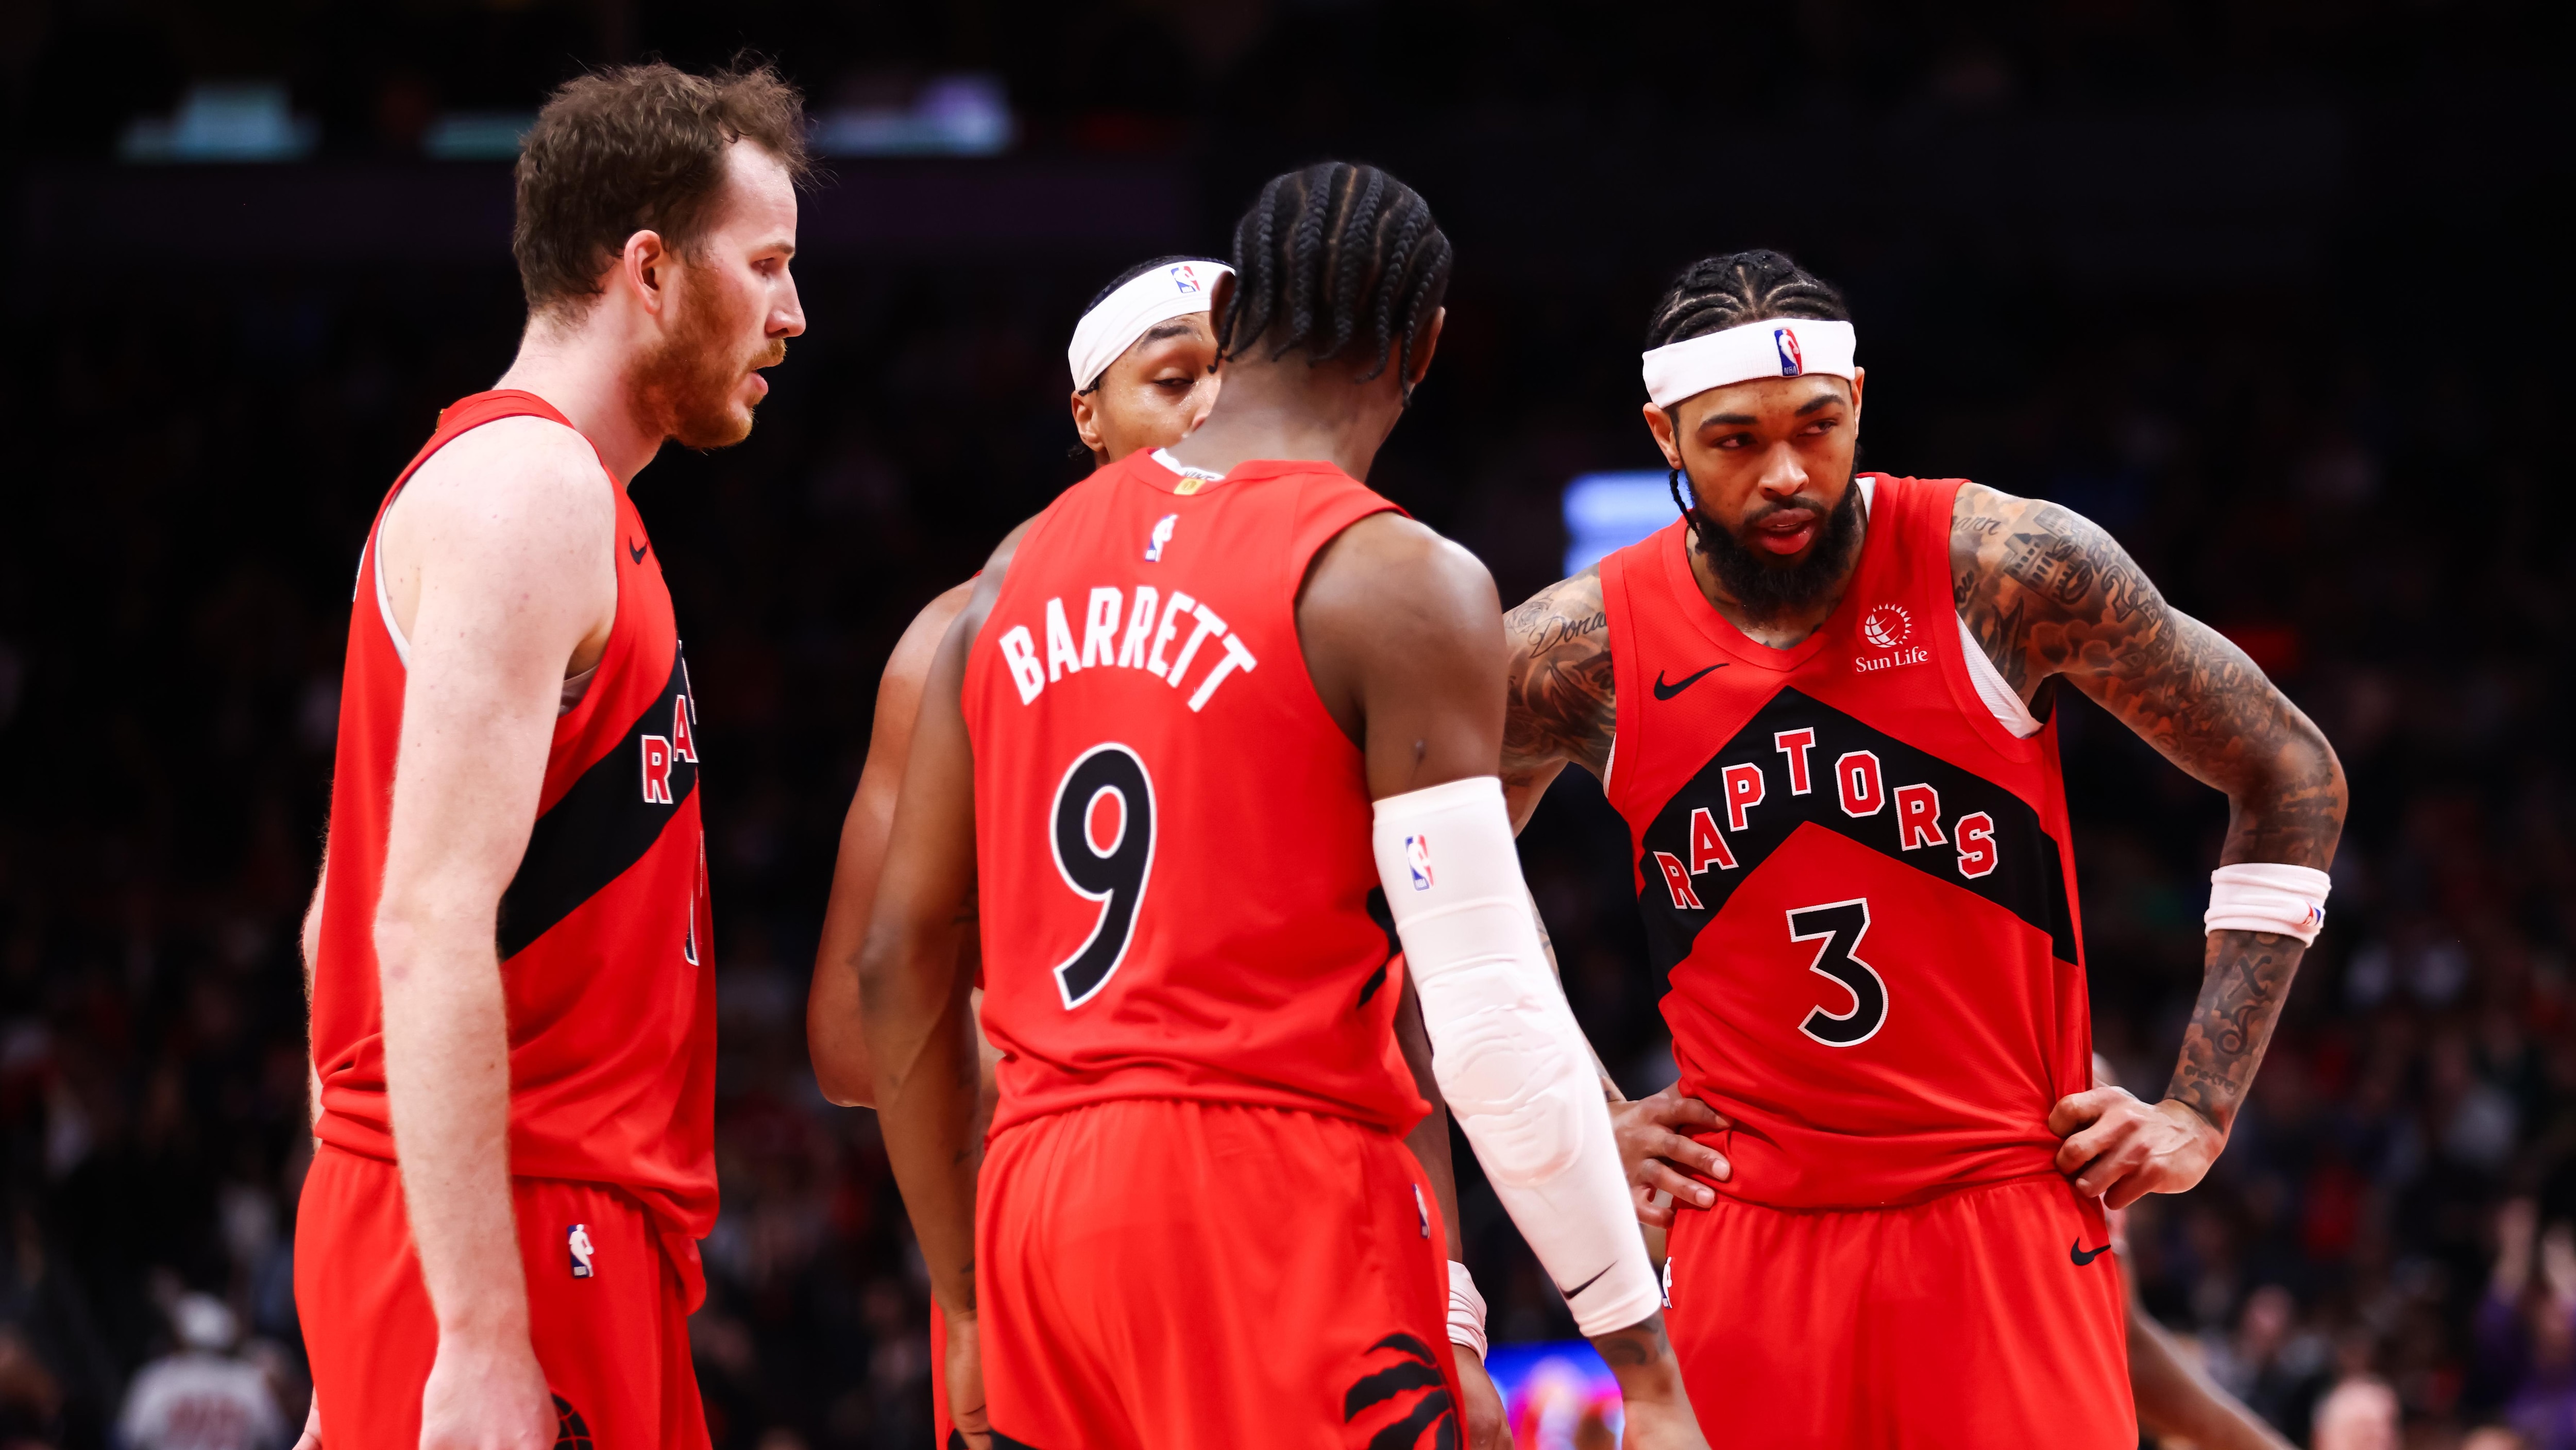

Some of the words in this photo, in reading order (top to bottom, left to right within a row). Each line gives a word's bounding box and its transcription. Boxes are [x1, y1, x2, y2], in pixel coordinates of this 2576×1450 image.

[1784, 366, 1797, 375] NBA
[999, 585, 1258, 713] BARRETT
[1528, 611, 1607, 659] Dona
[1855, 656, 1891, 672] Sun
[1893, 646, 1928, 666] Life
[641, 657, 700, 804] RA
[1050, 742, 1158, 1010] 9
[1653, 727, 1998, 910] RAPTORS
[1786, 898, 1889, 1048] 3
